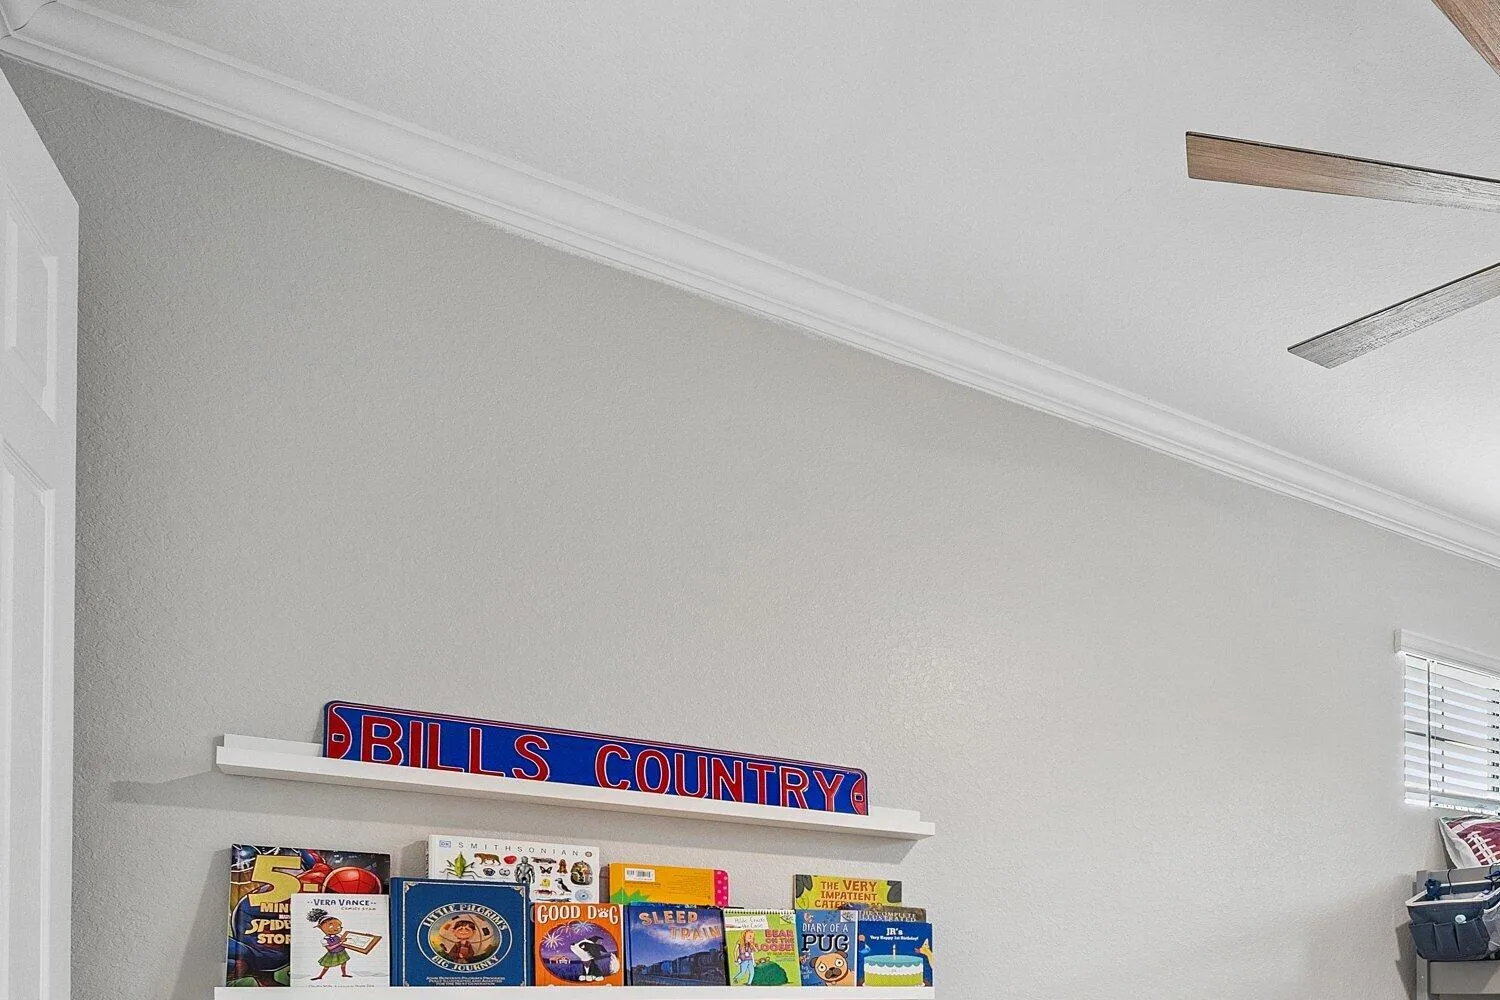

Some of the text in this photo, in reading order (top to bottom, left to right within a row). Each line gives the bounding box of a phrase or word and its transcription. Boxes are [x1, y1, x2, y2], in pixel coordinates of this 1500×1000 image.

[361, 715, 845, 812] BILLS COUNTRY
[458, 841, 579, 856] SMITHSONIAN
[821, 879, 877, 891] THE VERY
[313, 898, 370, 906] VERA VANCE
[821, 890, 878, 901] IMPATIENT
[260, 902, 291, 913] MIN
[537, 905, 581, 924] GOOD
[423, 904, 457, 927] LITTLE
[639, 911, 698, 926] SLEEP
[669, 926, 721, 940] TRAIN
[802, 923, 849, 932] DIARY OF A
[801, 934, 850, 953] PUG
[451, 955, 499, 971] JOURNEY
